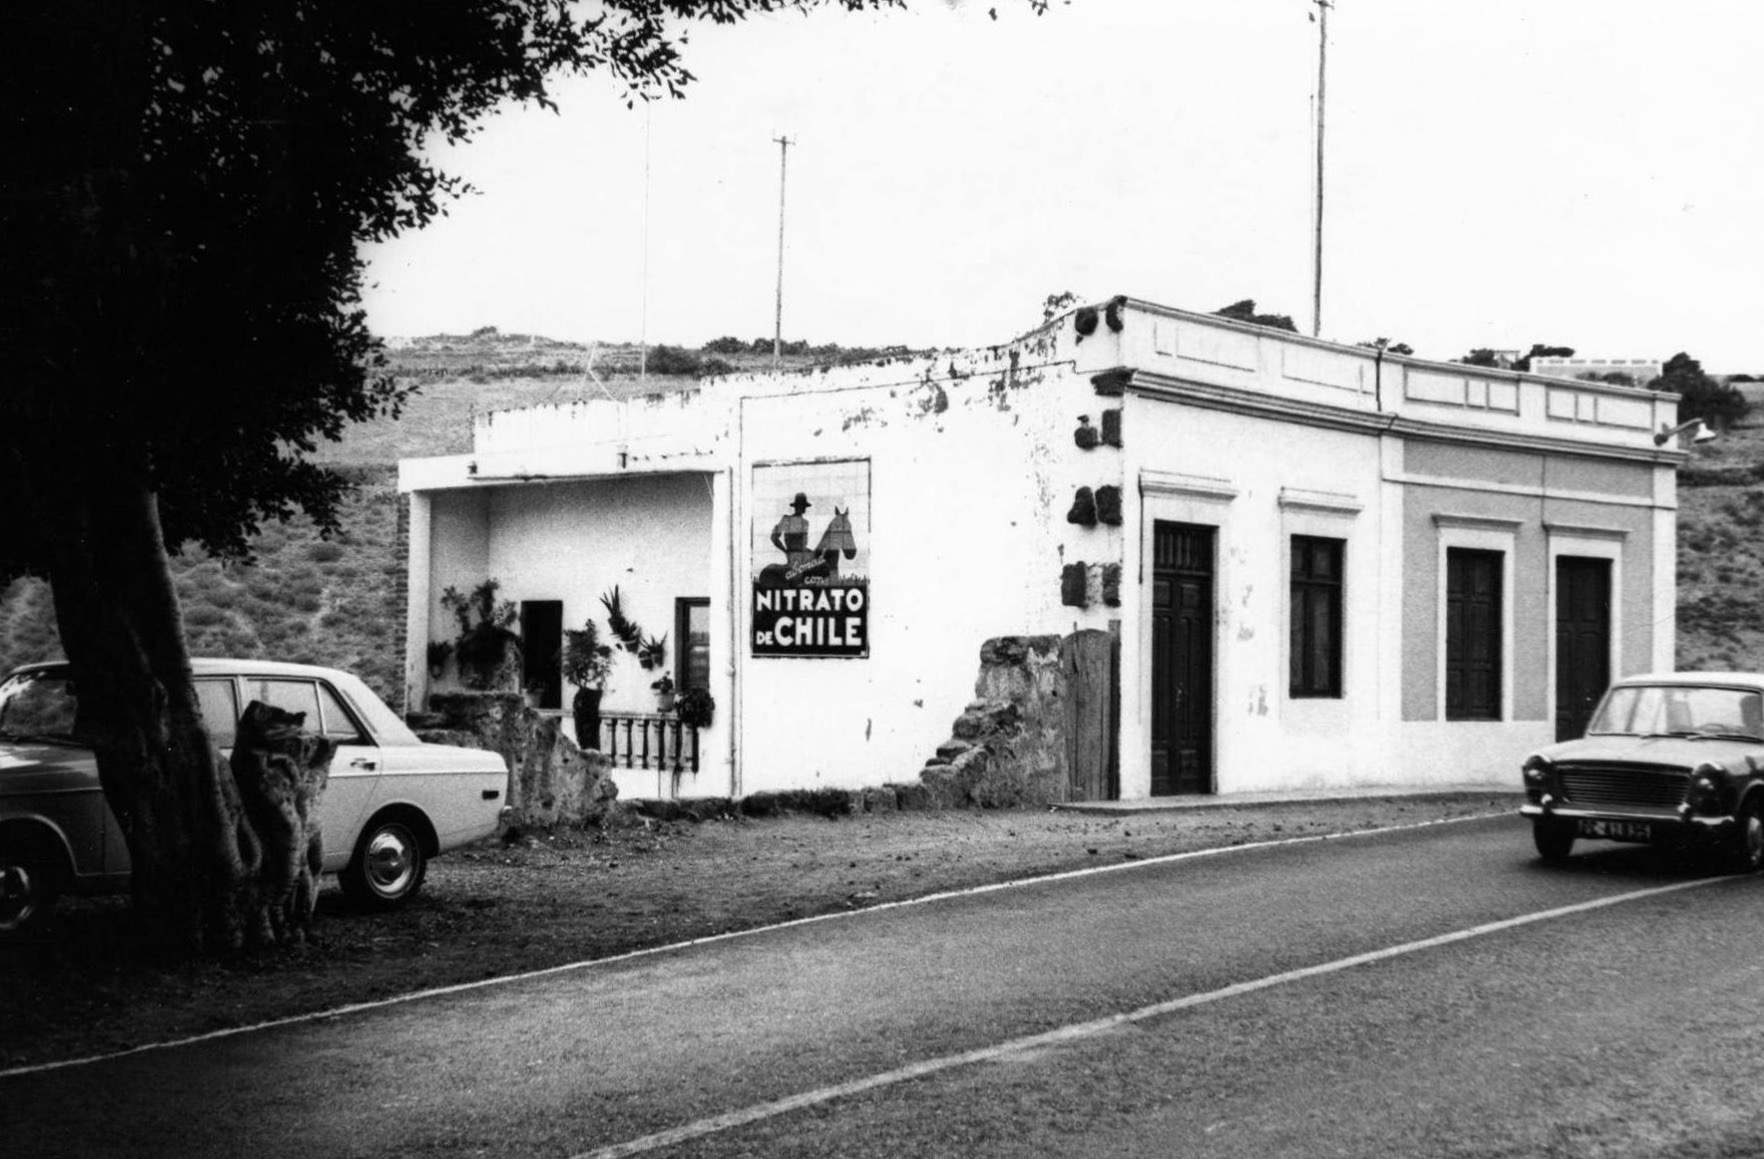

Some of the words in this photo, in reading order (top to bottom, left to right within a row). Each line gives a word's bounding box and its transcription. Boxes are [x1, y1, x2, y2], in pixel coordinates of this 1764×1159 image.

[756, 588, 863, 612] NITRATO
[756, 631, 774, 646] DE
[774, 616, 862, 646] CHILE
